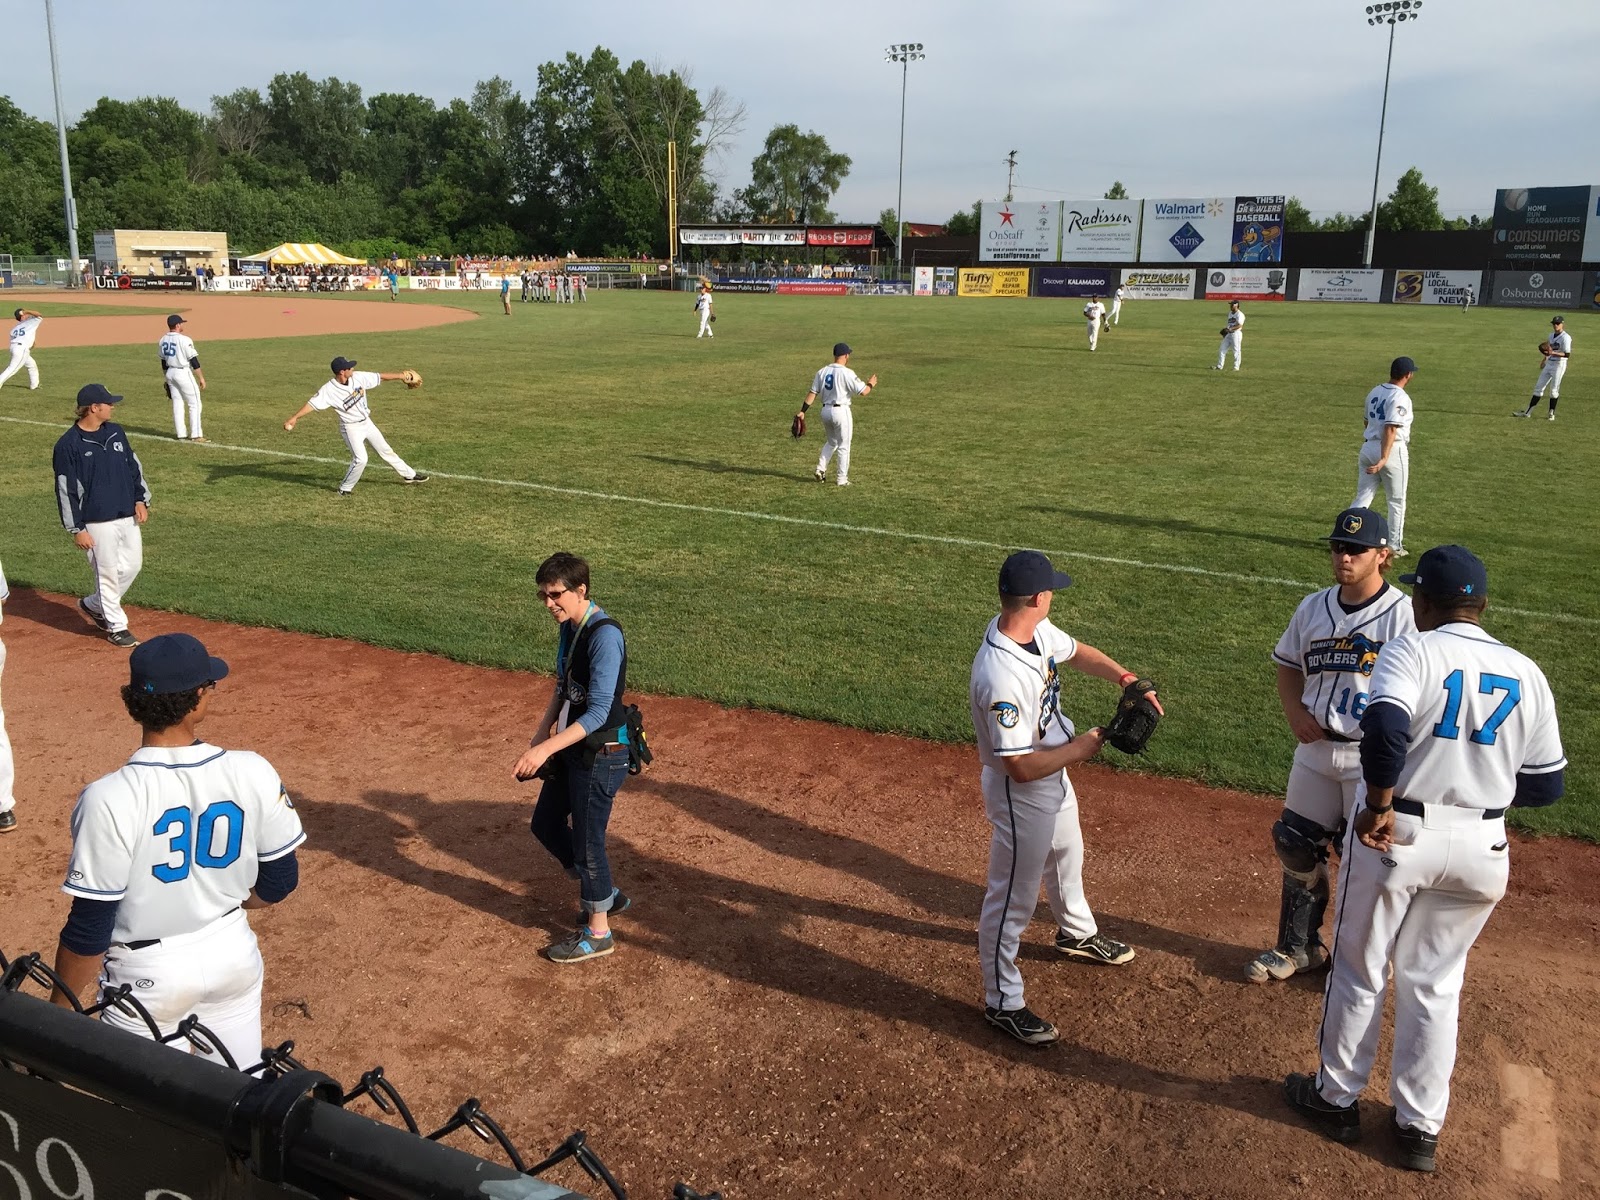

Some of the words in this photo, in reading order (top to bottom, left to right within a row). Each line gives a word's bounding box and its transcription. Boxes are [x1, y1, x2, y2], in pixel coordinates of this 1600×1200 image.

[1256, 196, 1273, 204] THIS
[1275, 195, 1284, 203] IS
[1155, 202, 1206, 215] Walmart
[1068, 206, 1132, 234] Radisson
[1235, 213, 1281, 222] BASEBALL
[1525, 216, 1580, 224] HEADQUARTERS
[743, 232, 766, 241] PARTY
[784, 233, 805, 242] ZONE
[989, 229, 1025, 240] OnStaff
[1507, 229, 1581, 243] consumers
[993, 252, 1041, 260] onstaffgroup.net
[95, 275, 131, 289] UniQ
[417, 279, 441, 288] PARTY
[963, 272, 992, 284] Tuffy
[738, 283, 752, 291] Public
[753, 284, 769, 293] Library
[1501, 287, 1572, 299] OsborneKlein
[162, 341, 177, 357] 25
[824, 373, 834, 391] 9
[1432, 668, 1521, 746] 17
[151, 800, 245, 884] 30
